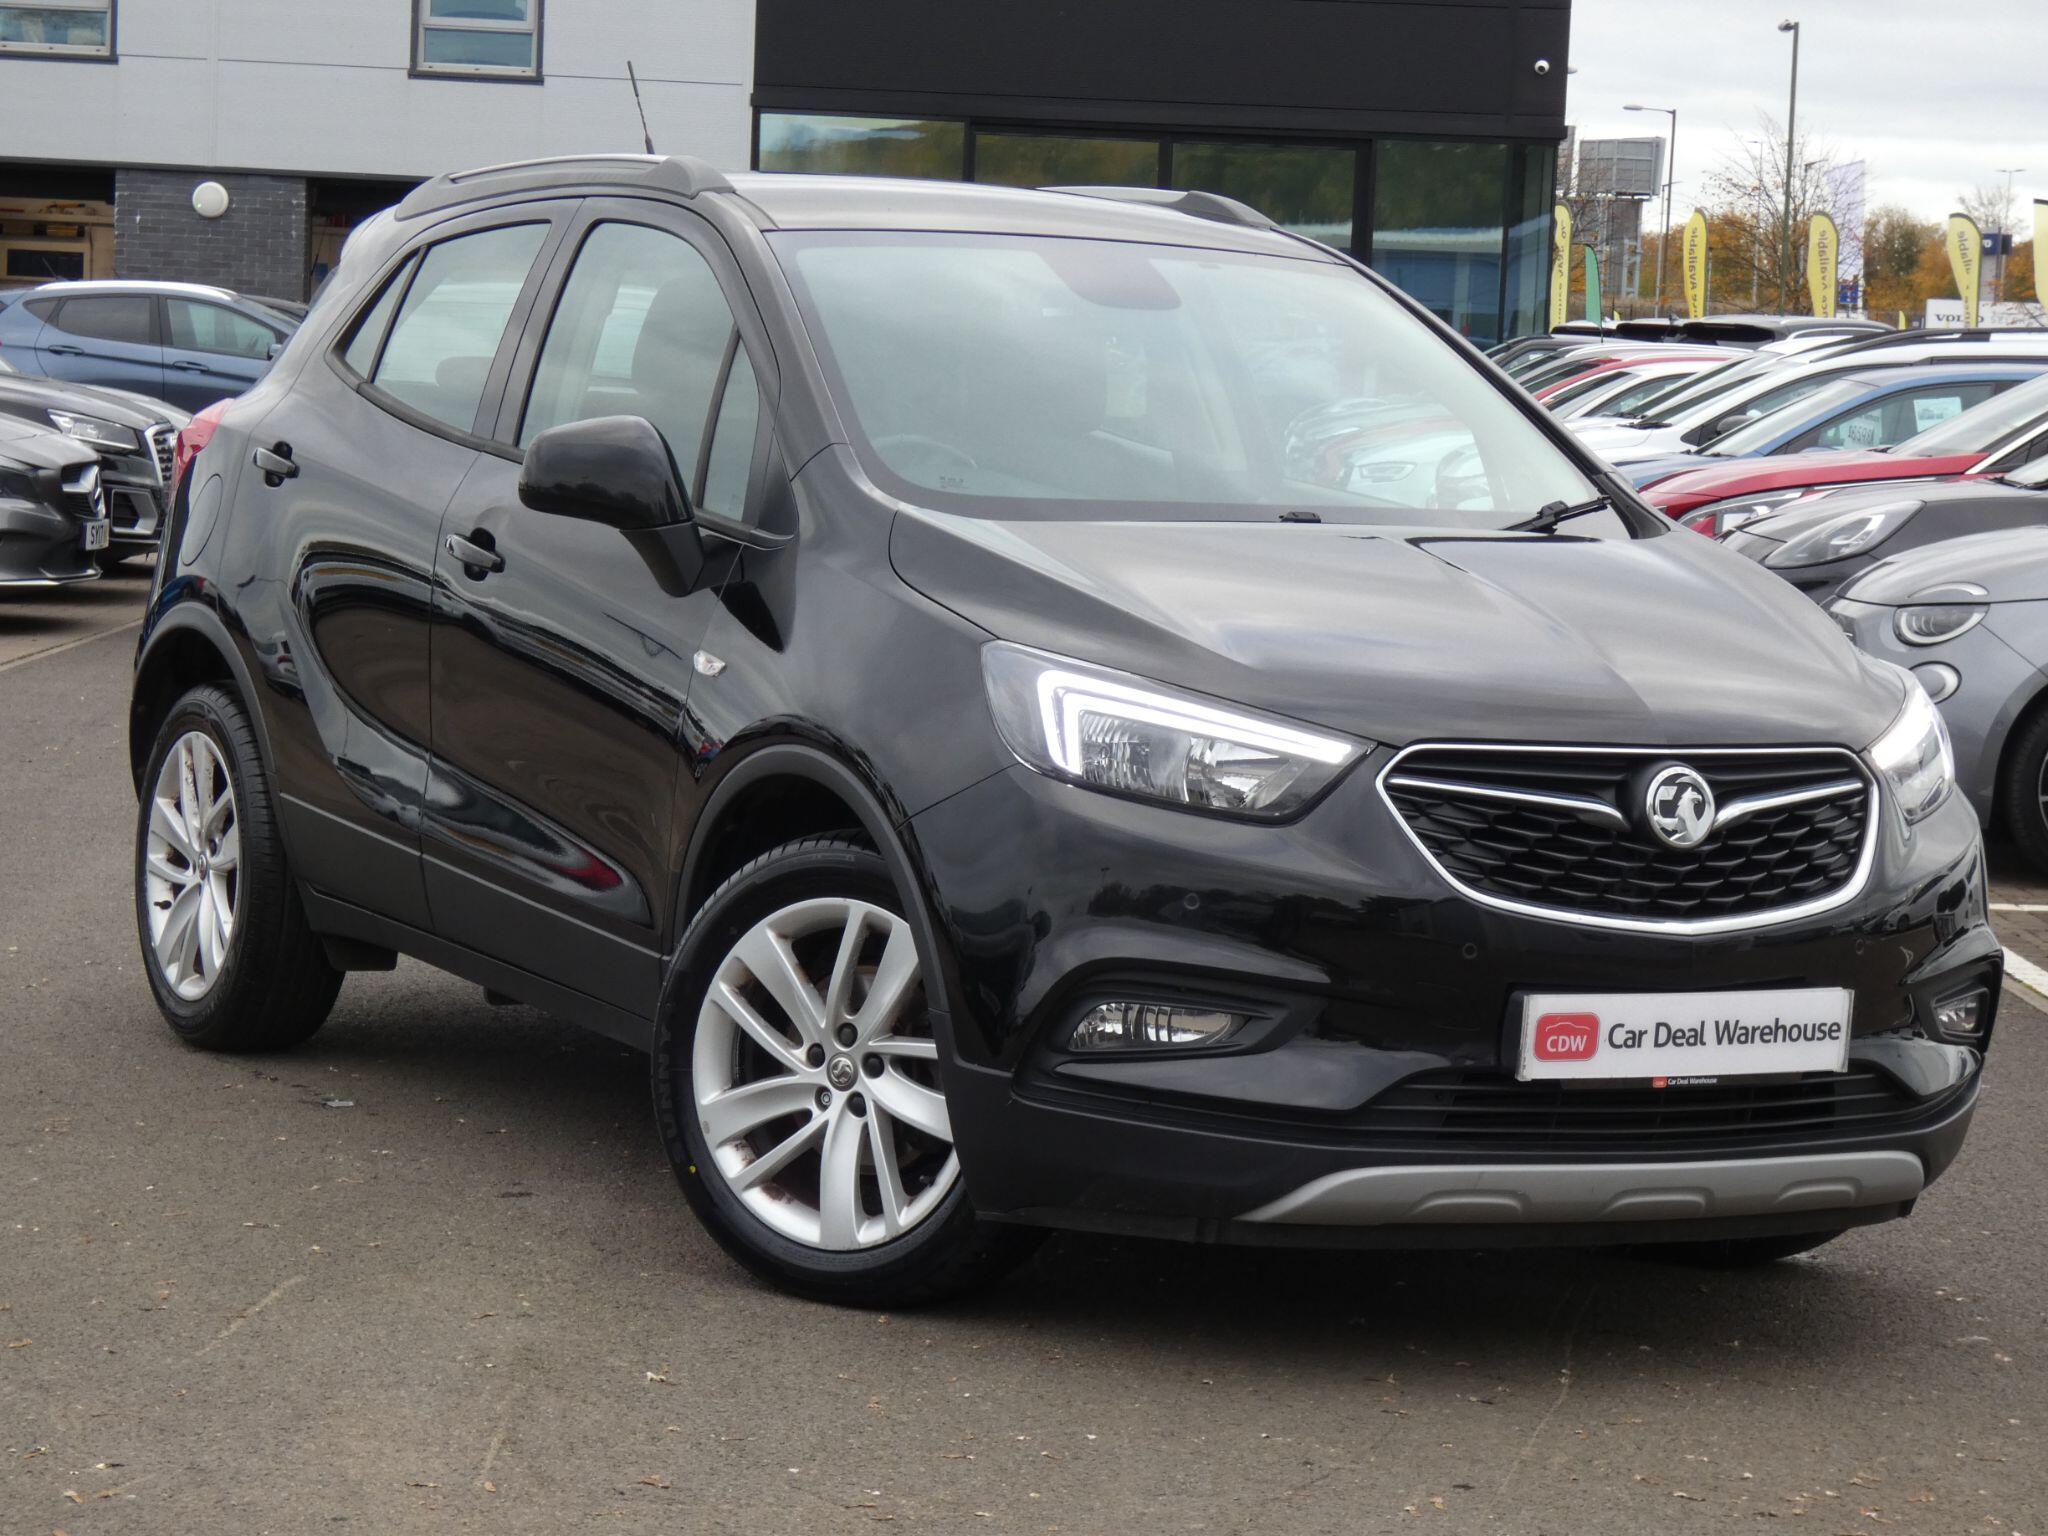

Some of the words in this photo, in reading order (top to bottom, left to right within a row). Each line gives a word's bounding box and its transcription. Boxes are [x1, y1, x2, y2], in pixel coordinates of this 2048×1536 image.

[1936, 313, 1985, 322] VOLO
[1546, 1035, 1587, 1052] CDW
[1607, 1023, 1648, 1049] Car
[1653, 1020, 1706, 1048] Deal
[1714, 1017, 1841, 1046] Warehouse
